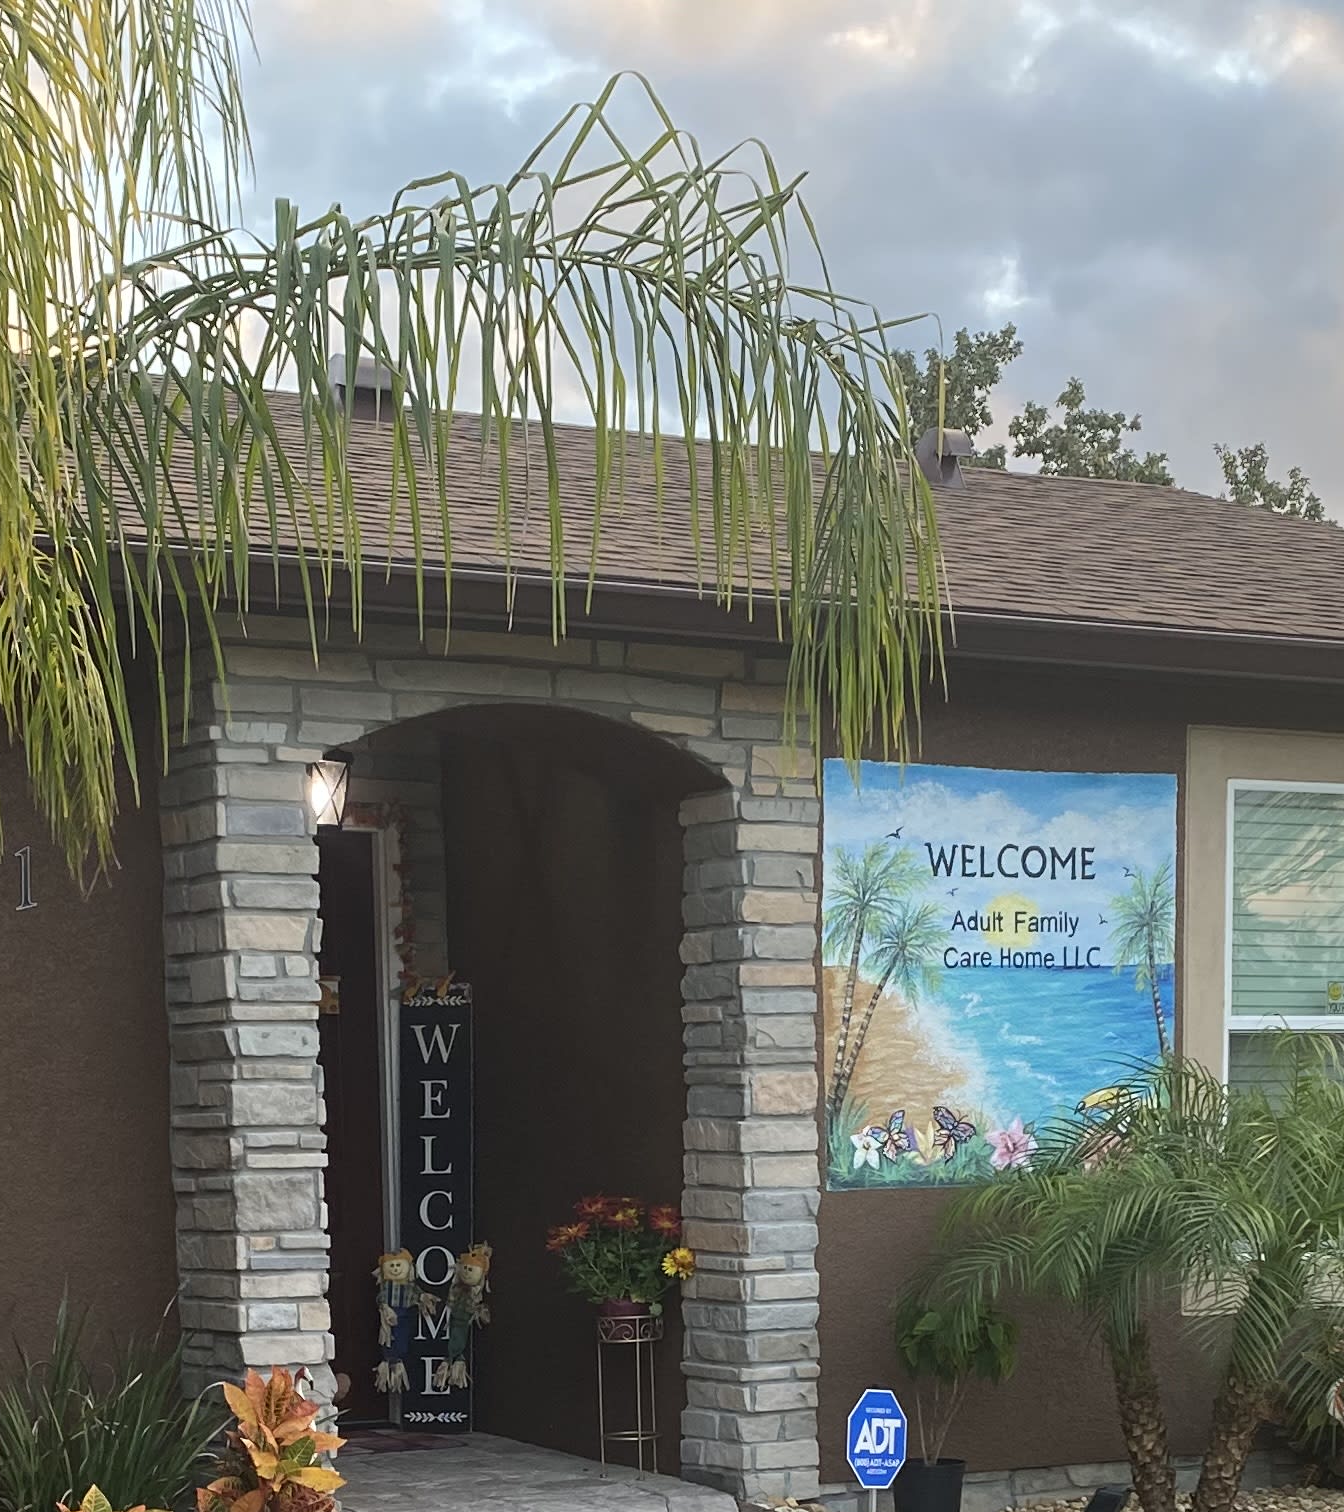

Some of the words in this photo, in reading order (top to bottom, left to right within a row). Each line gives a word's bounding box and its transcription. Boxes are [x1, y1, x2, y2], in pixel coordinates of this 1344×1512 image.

[924, 842, 1097, 880] WELCOME
[951, 909, 1004, 933] Adult
[1014, 910, 1080, 938] Family
[943, 946, 992, 969] Care
[1000, 946, 1055, 969] Home
[1063, 945, 1101, 970] LLC
[411, 1023, 461, 1396] WELCOME
[853, 1417, 902, 1456] ADT
